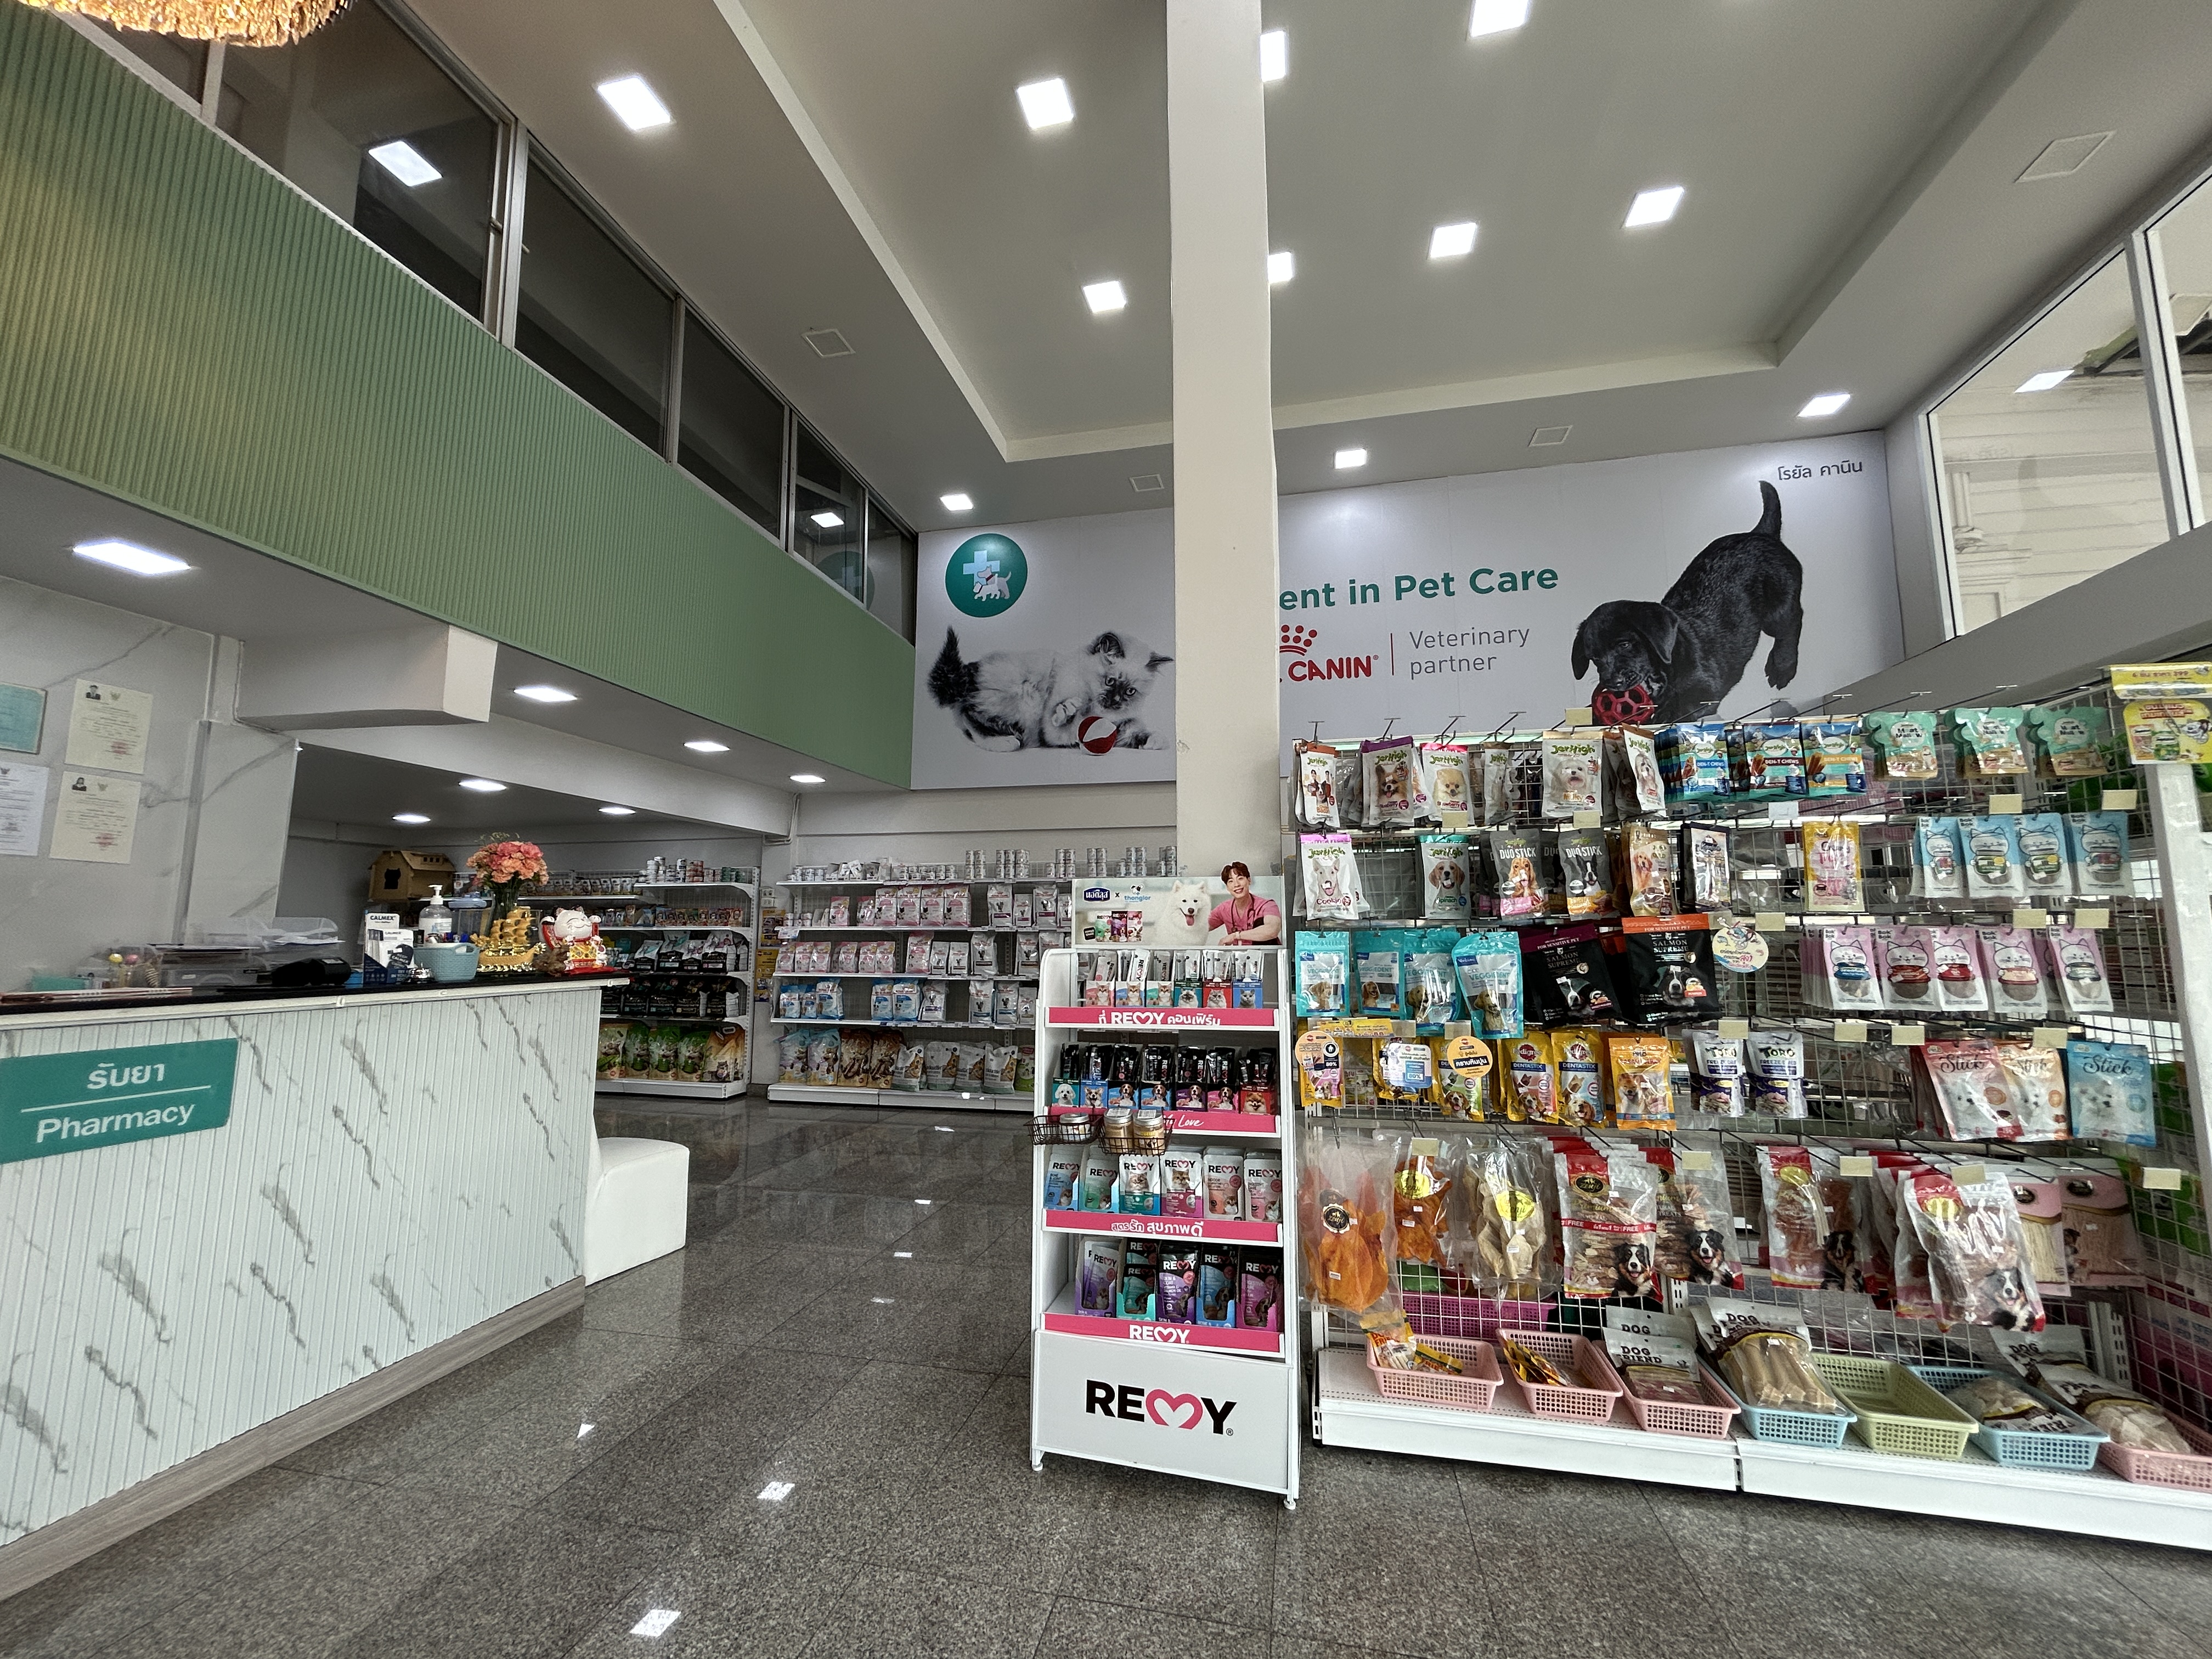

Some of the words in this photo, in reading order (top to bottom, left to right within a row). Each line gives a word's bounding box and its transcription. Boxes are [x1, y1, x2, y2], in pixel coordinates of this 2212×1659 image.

[1349, 579, 1380, 605] in
[1395, 572, 1455, 601] Pet
[1469, 568, 1558, 594] Care
[1409, 627, 1530, 649] Veterinary
[1410, 656, 1497, 680] partner
[1550, 743, 1595, 755] JerHigh
[1375, 750, 1407, 765] JerHigh
[1430, 755, 1463, 766] JerHigh
[1499, 848, 1515, 859] DUO
[1515, 847, 1536, 857] STICK
[1566, 847, 1581, 858] DUO
[1581, 845, 1602, 857] STICK
[1547, 939, 1571, 948] SENSITIVE
[1546, 952, 1579, 963] SALMON
[1136, 959, 1144, 981] REMY
[1111, 1011, 1165, 1024] REMY
[1512, 1045, 1542, 1057] Pedigree
[1758, 1046, 1795, 1058] TORO
[1940, 1053, 1984, 1073] Stick
[2083, 1054, 2134, 1075] Stick
[87, 1063, 165, 1090] รับยา
[36, 1104, 196, 1143] Pharmacy
[1178, 1114, 1204, 1127] Love
[1124, 1163, 1154, 1171] REMY
[1165, 1159, 1196, 1169] REMY
[1208, 1165, 1240, 1174] REMY
[1248, 1169, 1282, 1178] REMY
[1093, 1254, 1117, 1267] REMY
[1164, 1260, 1197, 1270] REMY
[1246, 1262, 1279, 1274] REMY
[1726, 1313, 1760, 1325] DOG
[1129, 1324, 1190, 1344] REMY
[1621, 1324, 1651, 1335] DOG
[1621, 1345, 1651, 1356] DOG
[1085, 1379, 1237, 1435] REMY
